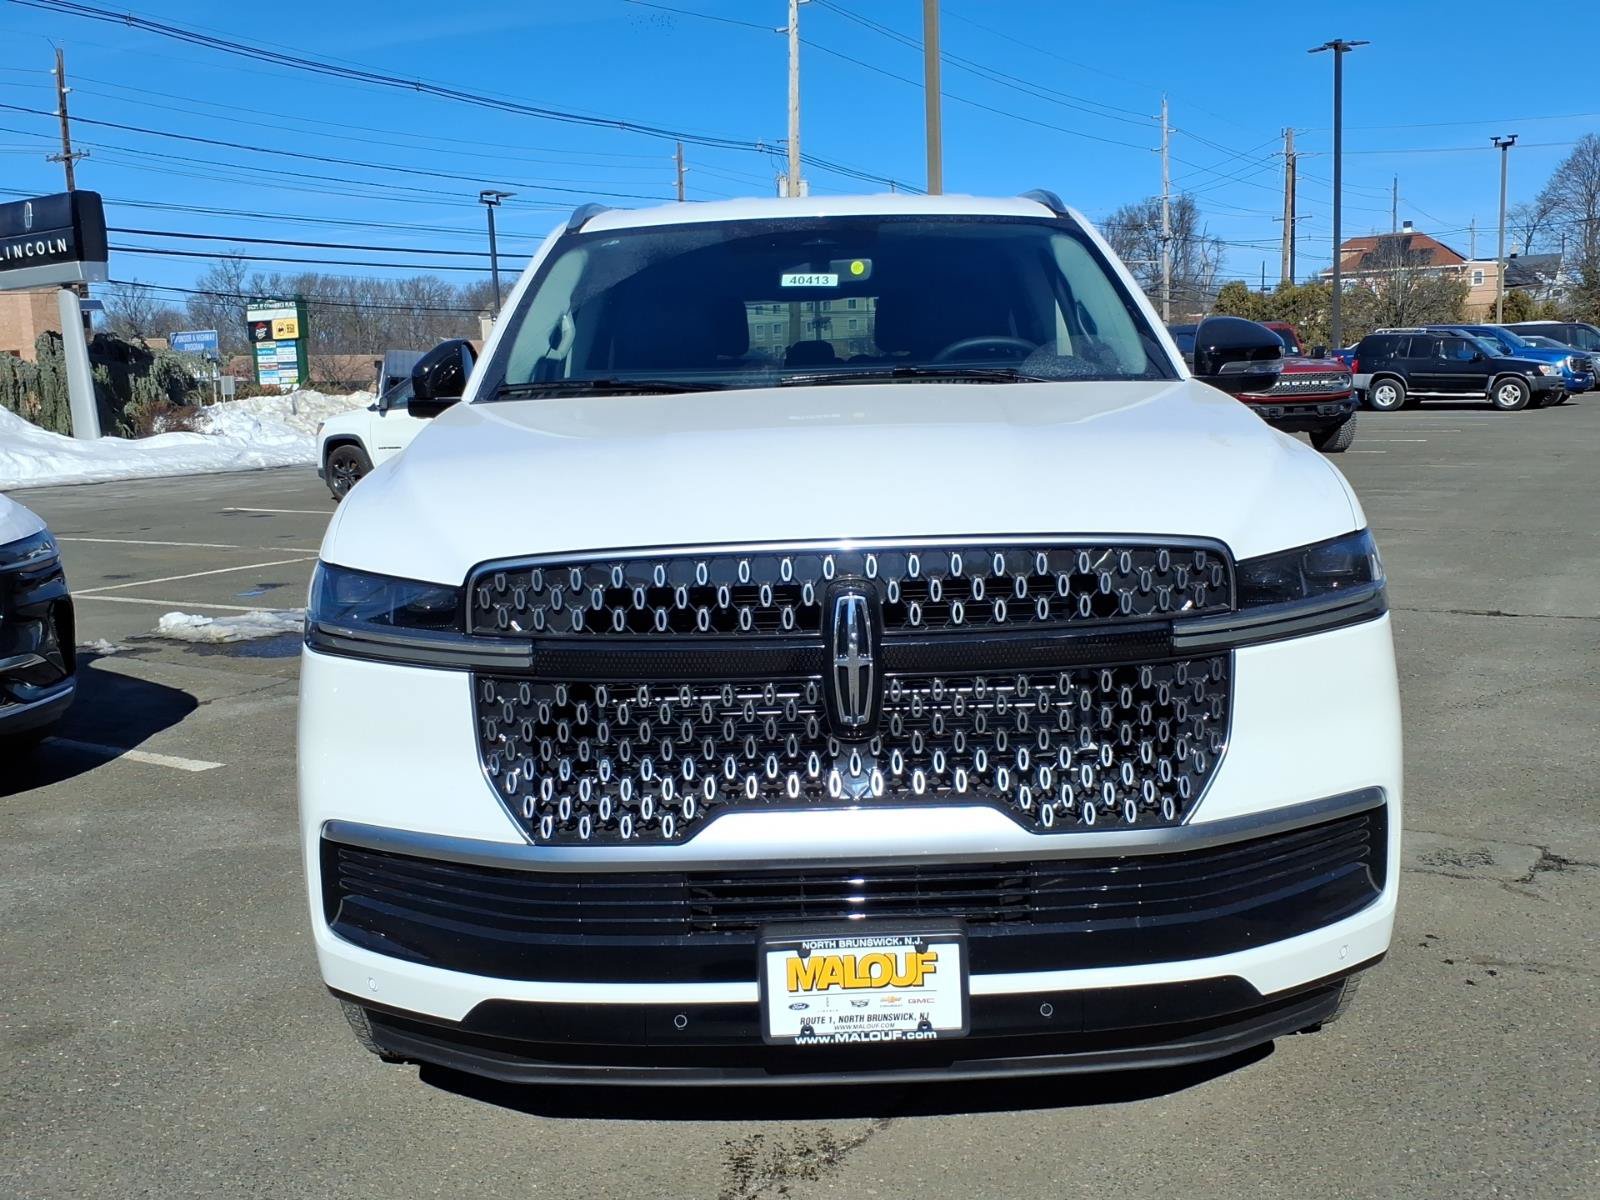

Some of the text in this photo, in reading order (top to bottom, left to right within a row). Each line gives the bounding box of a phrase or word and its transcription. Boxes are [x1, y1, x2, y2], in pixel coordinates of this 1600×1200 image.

[789, 275, 830, 285] 40413
[802, 941, 836, 950] NORTH
[905, 937, 924, 945] N.J.
[786, 952, 938, 992] MALOUF
[800, 1016, 826, 1025] ROUTE
[838, 1014, 865, 1023] NORTH
[867, 1012, 917, 1022] BRUNSWICK,
[919, 1012, 930, 1021] NJ
[834, 1022, 895, 1030] WWW.MALOUF.COM
[794, 1030, 938, 1045] www.MALOUF.com
